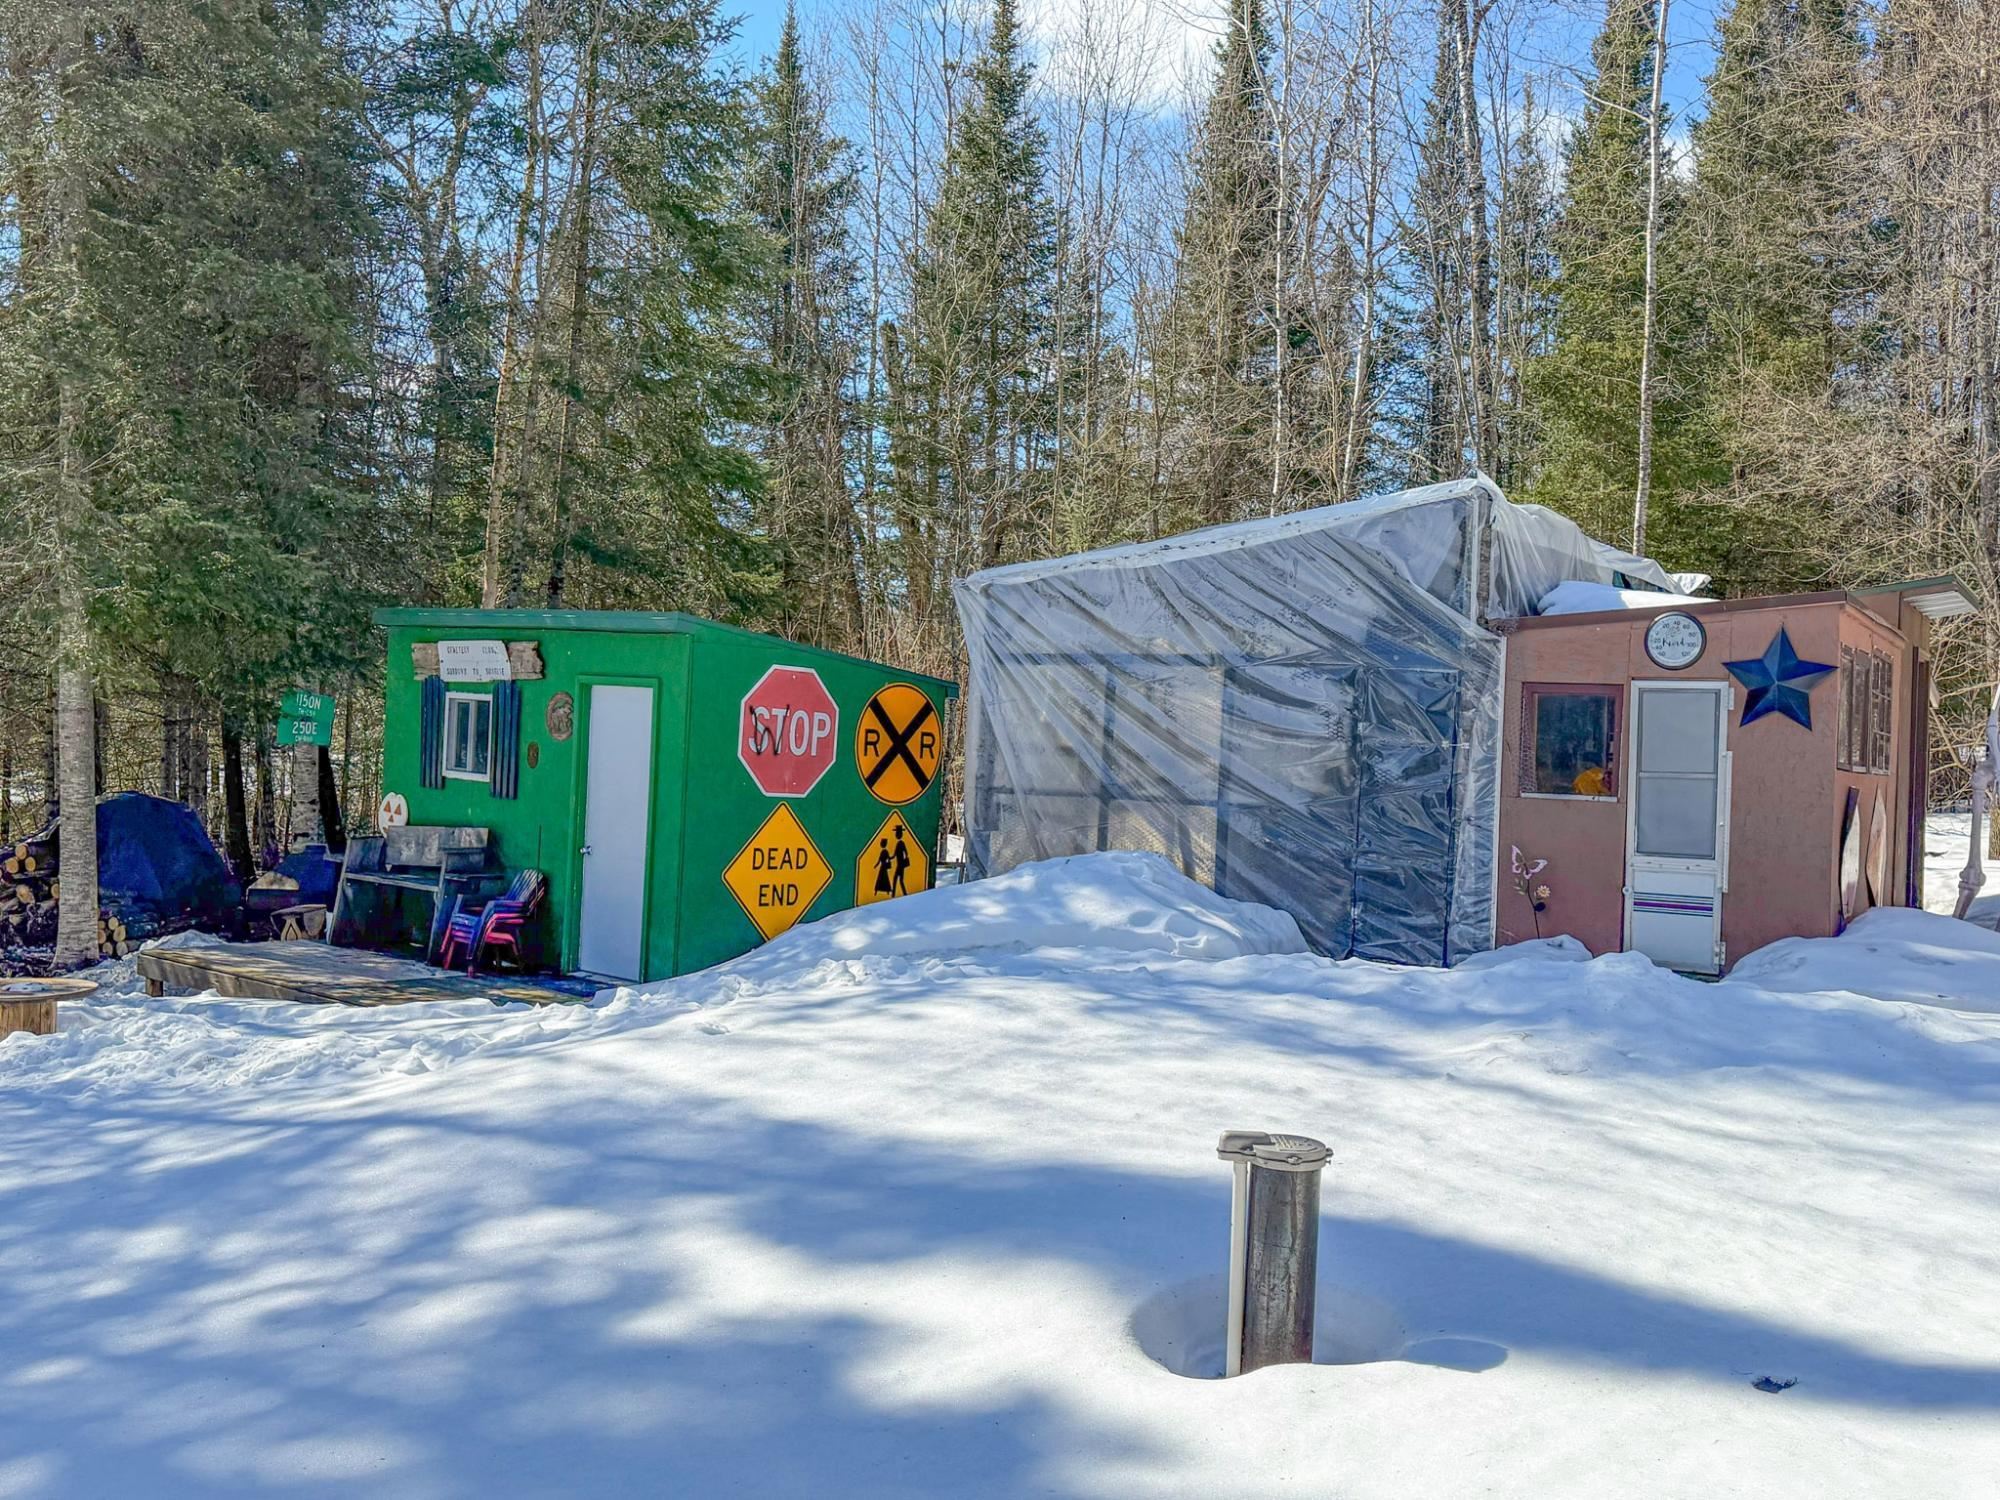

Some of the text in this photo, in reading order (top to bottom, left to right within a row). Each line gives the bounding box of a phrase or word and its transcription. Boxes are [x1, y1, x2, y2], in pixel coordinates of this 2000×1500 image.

[292, 721, 319, 735] 250E
[748, 705, 832, 757] STOP
[863, 728, 936, 760] R R
[752, 847, 808, 871] DEAD
[758, 884, 799, 908] END
